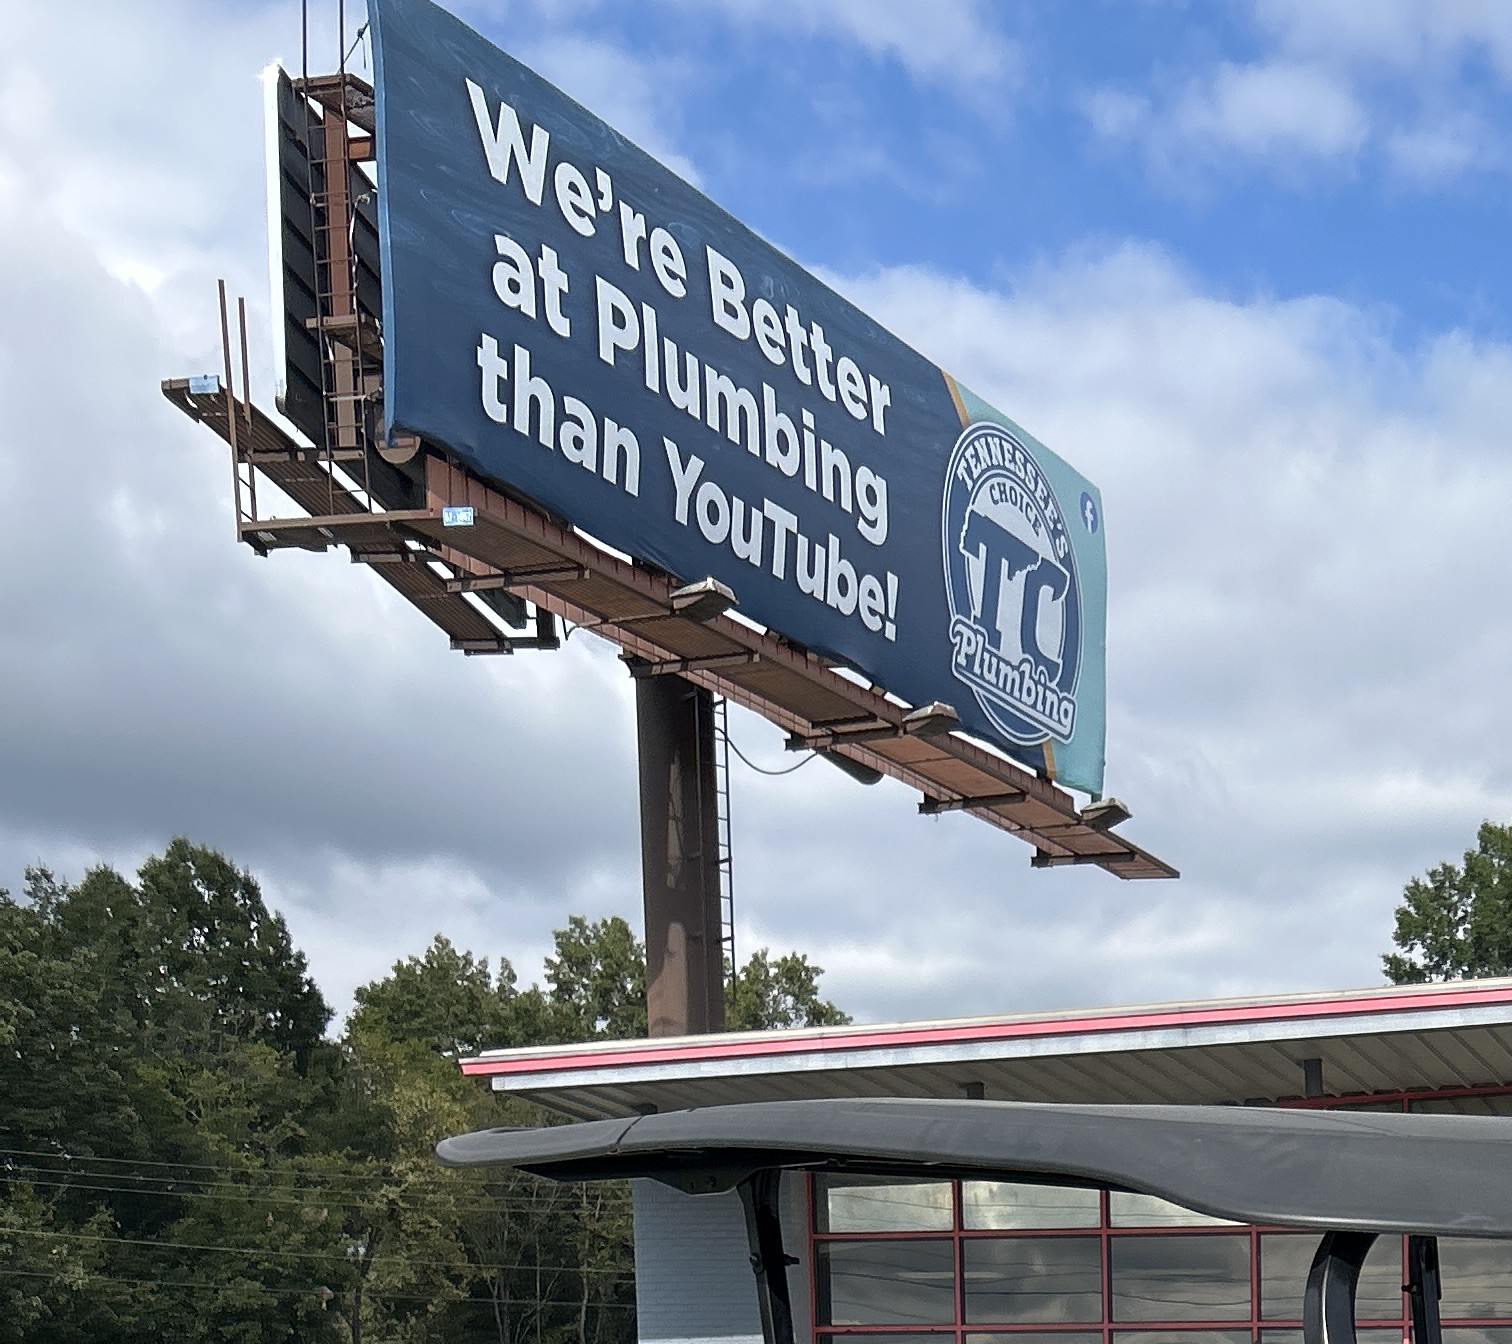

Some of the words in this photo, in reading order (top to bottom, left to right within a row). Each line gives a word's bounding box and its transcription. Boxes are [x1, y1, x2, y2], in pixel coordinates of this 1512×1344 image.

[466, 79, 688, 299] We're
[706, 245, 890, 437] Better
[477, 334, 639, 497] than
[662, 436, 898, 642] YouTube!
[493, 234, 570, 338] at
[596, 274, 888, 547] Plumbing
[957, 437, 1069, 559] TENNESSEE'S
[990, 482, 1042, 538] CHOICE
[955, 624, 1072, 727] Plumbing
